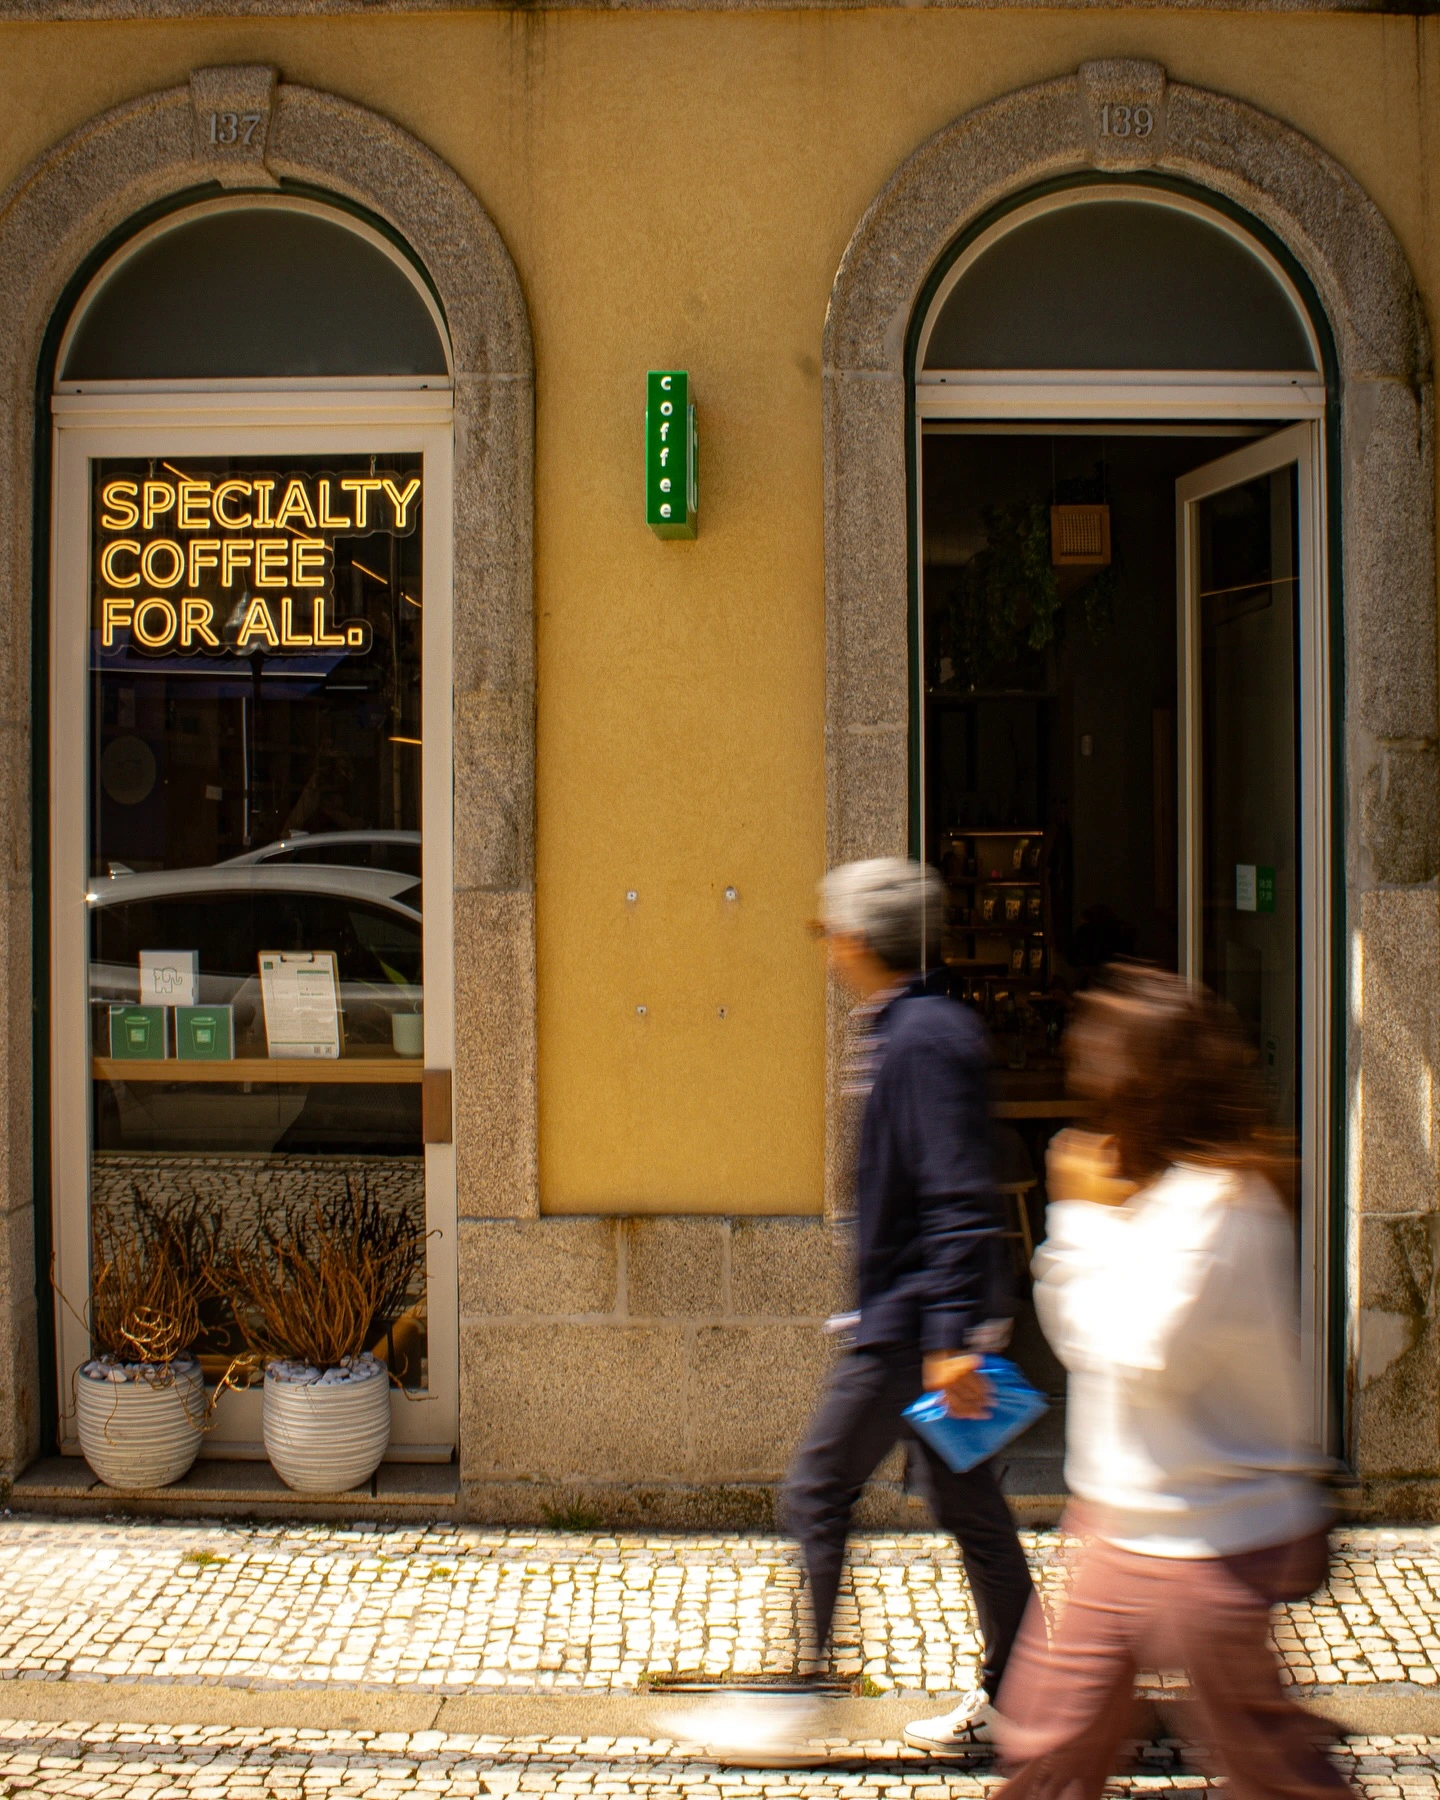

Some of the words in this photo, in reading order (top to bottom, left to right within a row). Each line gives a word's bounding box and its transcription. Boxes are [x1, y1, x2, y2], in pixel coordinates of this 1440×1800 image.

[208, 112, 261, 146] 137
[1101, 105, 1153, 138] 139
[659, 375, 673, 518] coffee
[101, 479, 421, 530] SPECIALTY
[101, 538, 326, 589] COFFEE
[102, 597, 220, 647] FOR
[237, 597, 363, 647] ALL.
